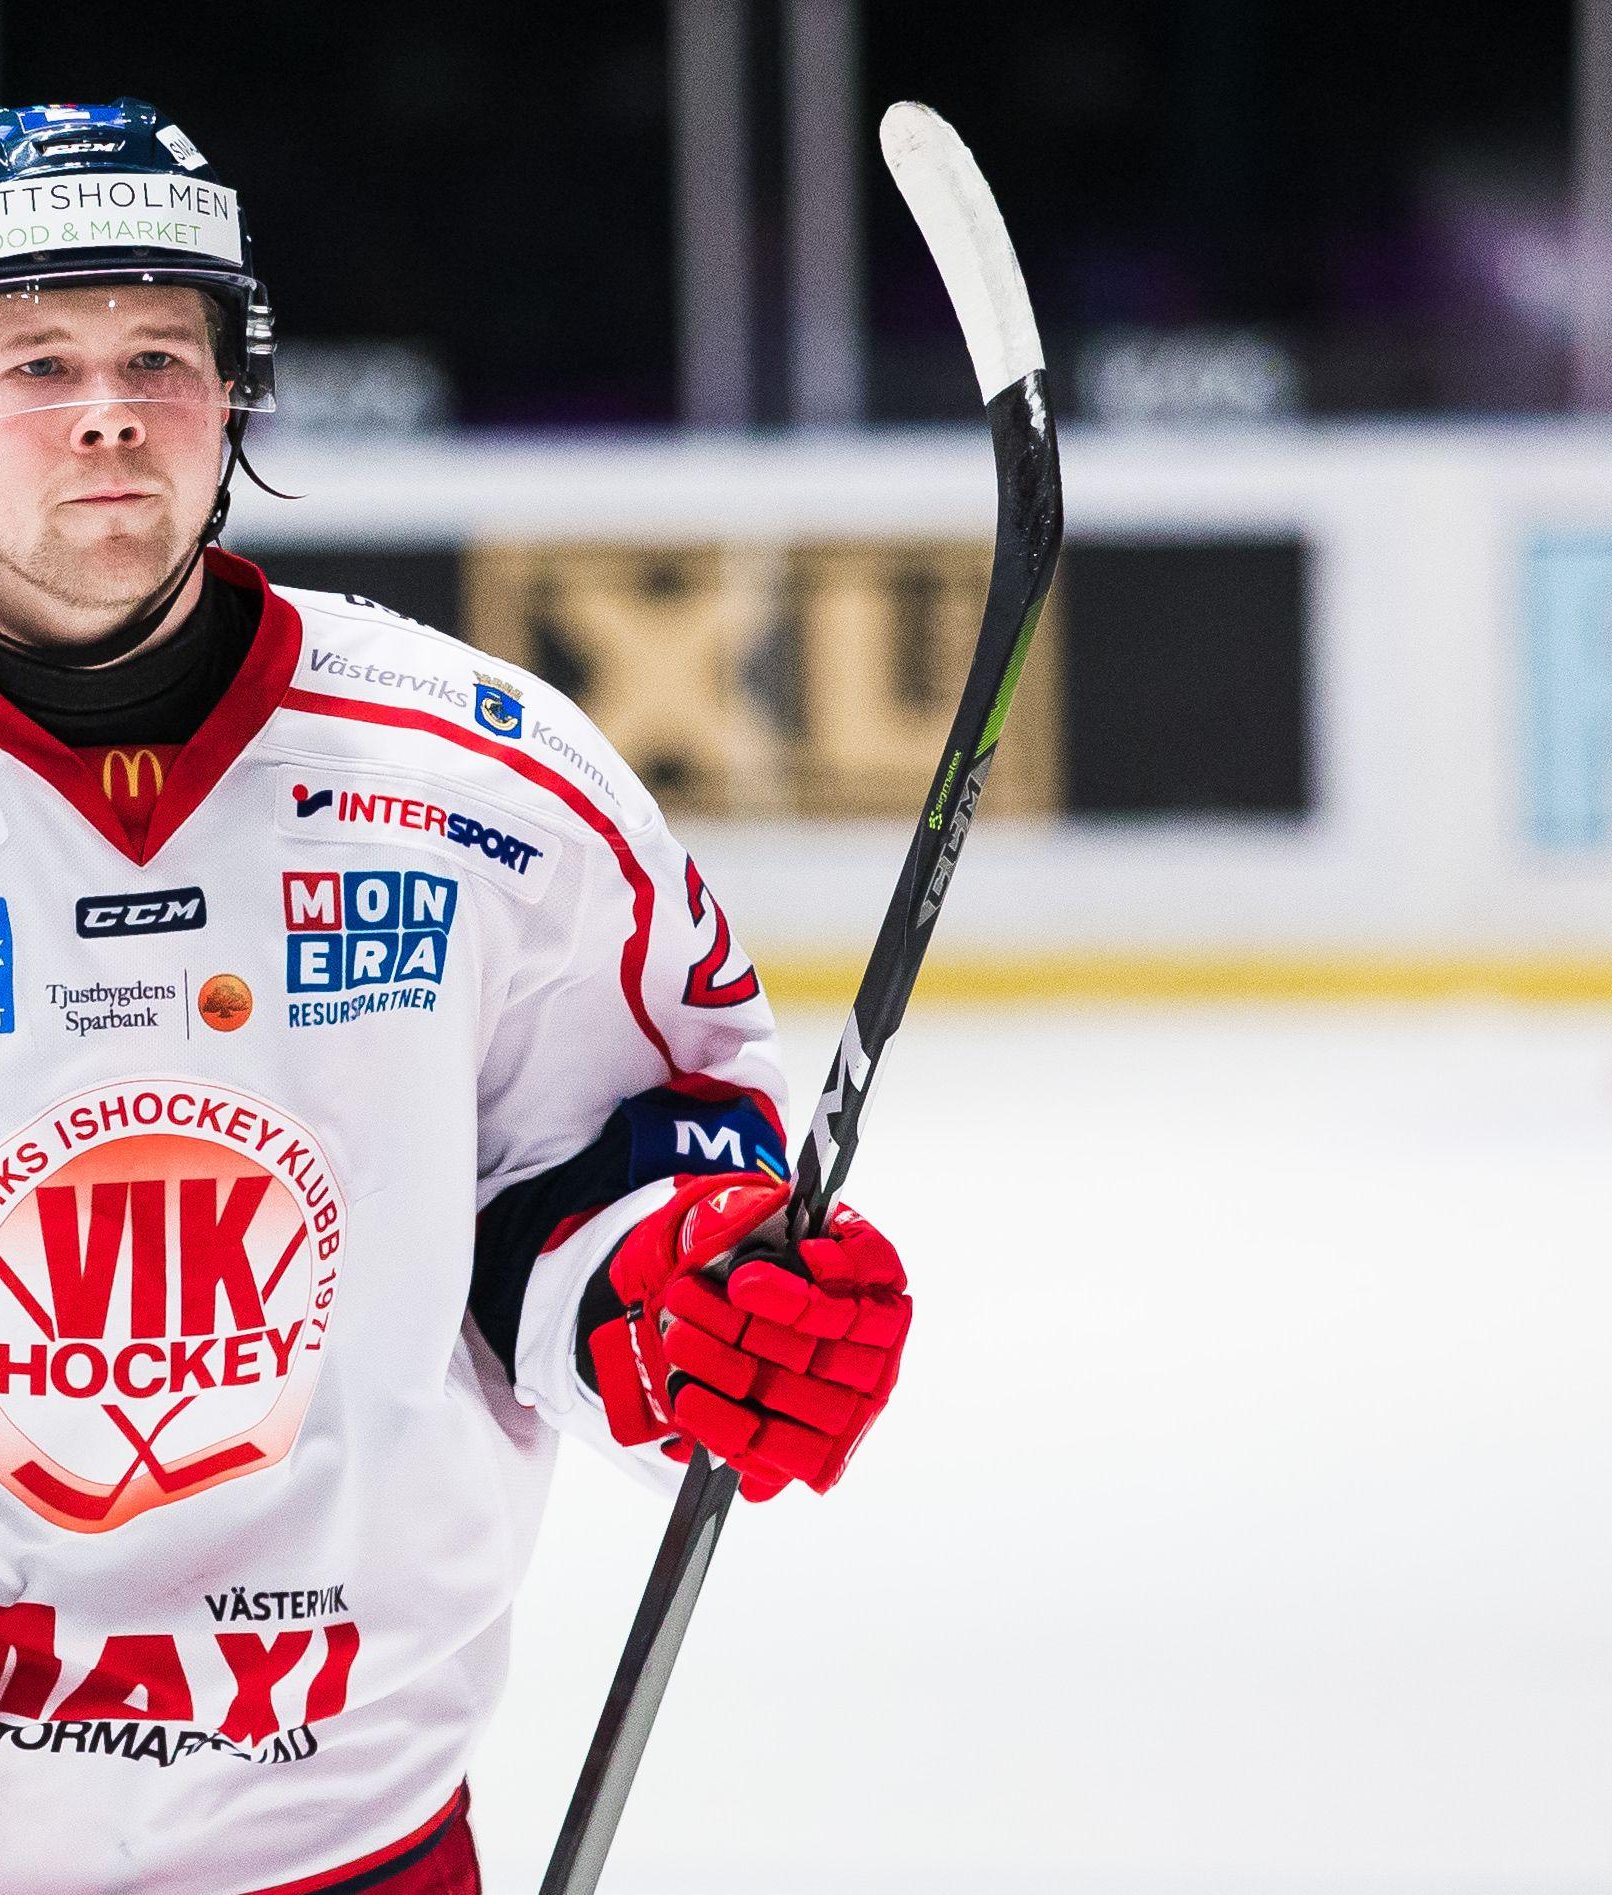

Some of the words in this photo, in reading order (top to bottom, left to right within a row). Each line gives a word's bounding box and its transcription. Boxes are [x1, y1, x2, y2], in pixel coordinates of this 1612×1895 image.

[61, 222, 80, 242] &
[90, 220, 202, 246] MARKET
[310, 648, 469, 709] Västerviks
[934, 749, 963, 813] sigmatex
[338, 790, 543, 875] INTERSPORT
[83, 898, 201, 929] CCM
[46, 980, 176, 1009] Tjustbygdens
[65, 1007, 159, 1037] Sparbank
[289, 987, 437, 1028] RESURSPARTNER
[53, 1091, 284, 1153] ISHOCKEY
[276, 1138, 341, 1262] KLUBB
[35, 1175, 274, 1340] VIK
[305, 1268, 340, 1352] 1971
[204, 1583, 349, 1623] VÄSTERVIK
